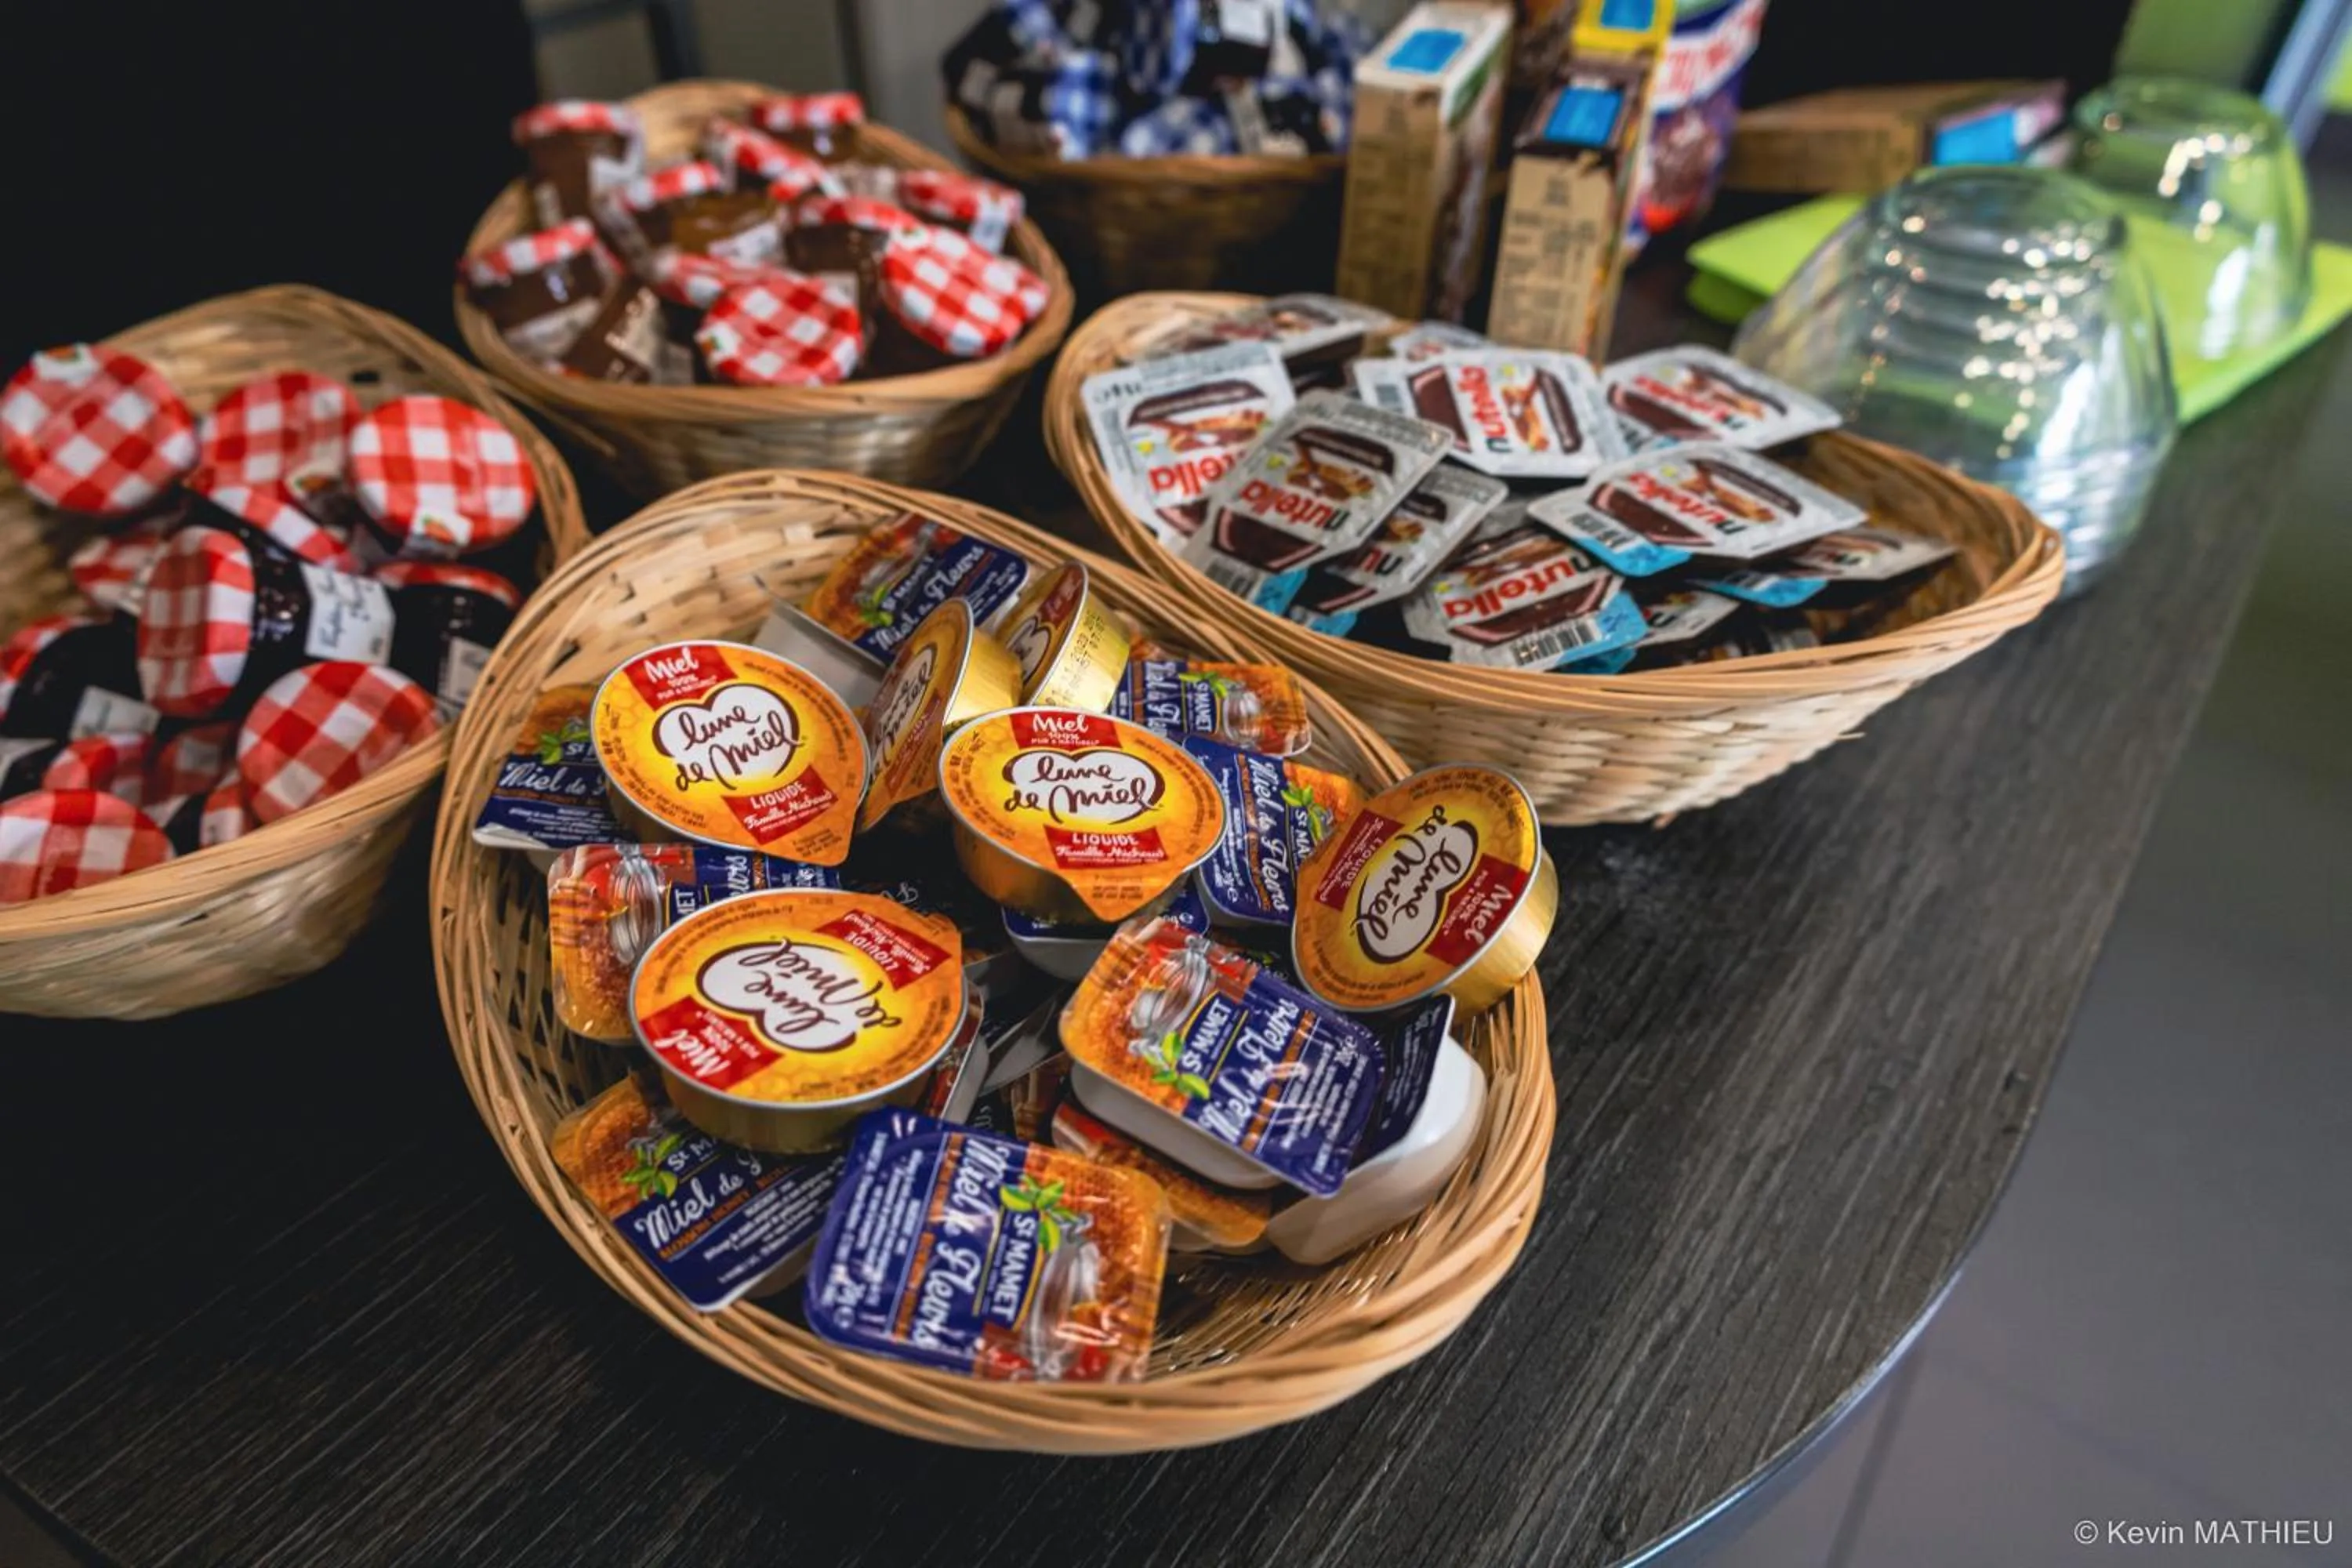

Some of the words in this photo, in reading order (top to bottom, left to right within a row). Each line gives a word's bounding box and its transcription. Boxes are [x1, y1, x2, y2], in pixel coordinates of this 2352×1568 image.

[1149, 452, 1232, 495] ella
[1240, 479, 1351, 531] nutella
[924, 546, 985, 600] Fleurs
[1442, 551, 1596, 620] nutella
[643, 646, 700, 684] Miel
[1032, 713, 1089, 740] Miel
[498, 761, 568, 793] Miel
[675, 760, 713, 792] de
[750, 780, 808, 809] LIQUIDE
[1004, 789, 1044, 812] de
[1248, 757, 1283, 818] Miel
[1072, 833, 1140, 846] LIQUIDE
[1414, 804, 1448, 837] de
[1260, 833, 1290, 913] Fleurs
[1341, 837, 1383, 888] LIQUIDE
[1464, 883, 1514, 945] Miel
[842, 931, 899, 972] LIQUIDE
[855, 997, 902, 1029] de
[1181, 1045, 1205, 1075] St
[1194, 996, 1234, 1054] MAMET
[654, 1028, 731, 1079] Miel
[1199, 1071, 1253, 1143] Miel
[1236, 998, 1300, 1071] Fleurs
[667, 1149, 690, 1171] St
[953, 1138, 1011, 1218] Miel
[634, 1178, 715, 1250] Miel
[719, 1172, 744, 1196] de
[1013, 1213, 1036, 1236] St
[913, 1241, 982, 1350] Fleurs
[991, 1235, 1032, 1321] MAMET
